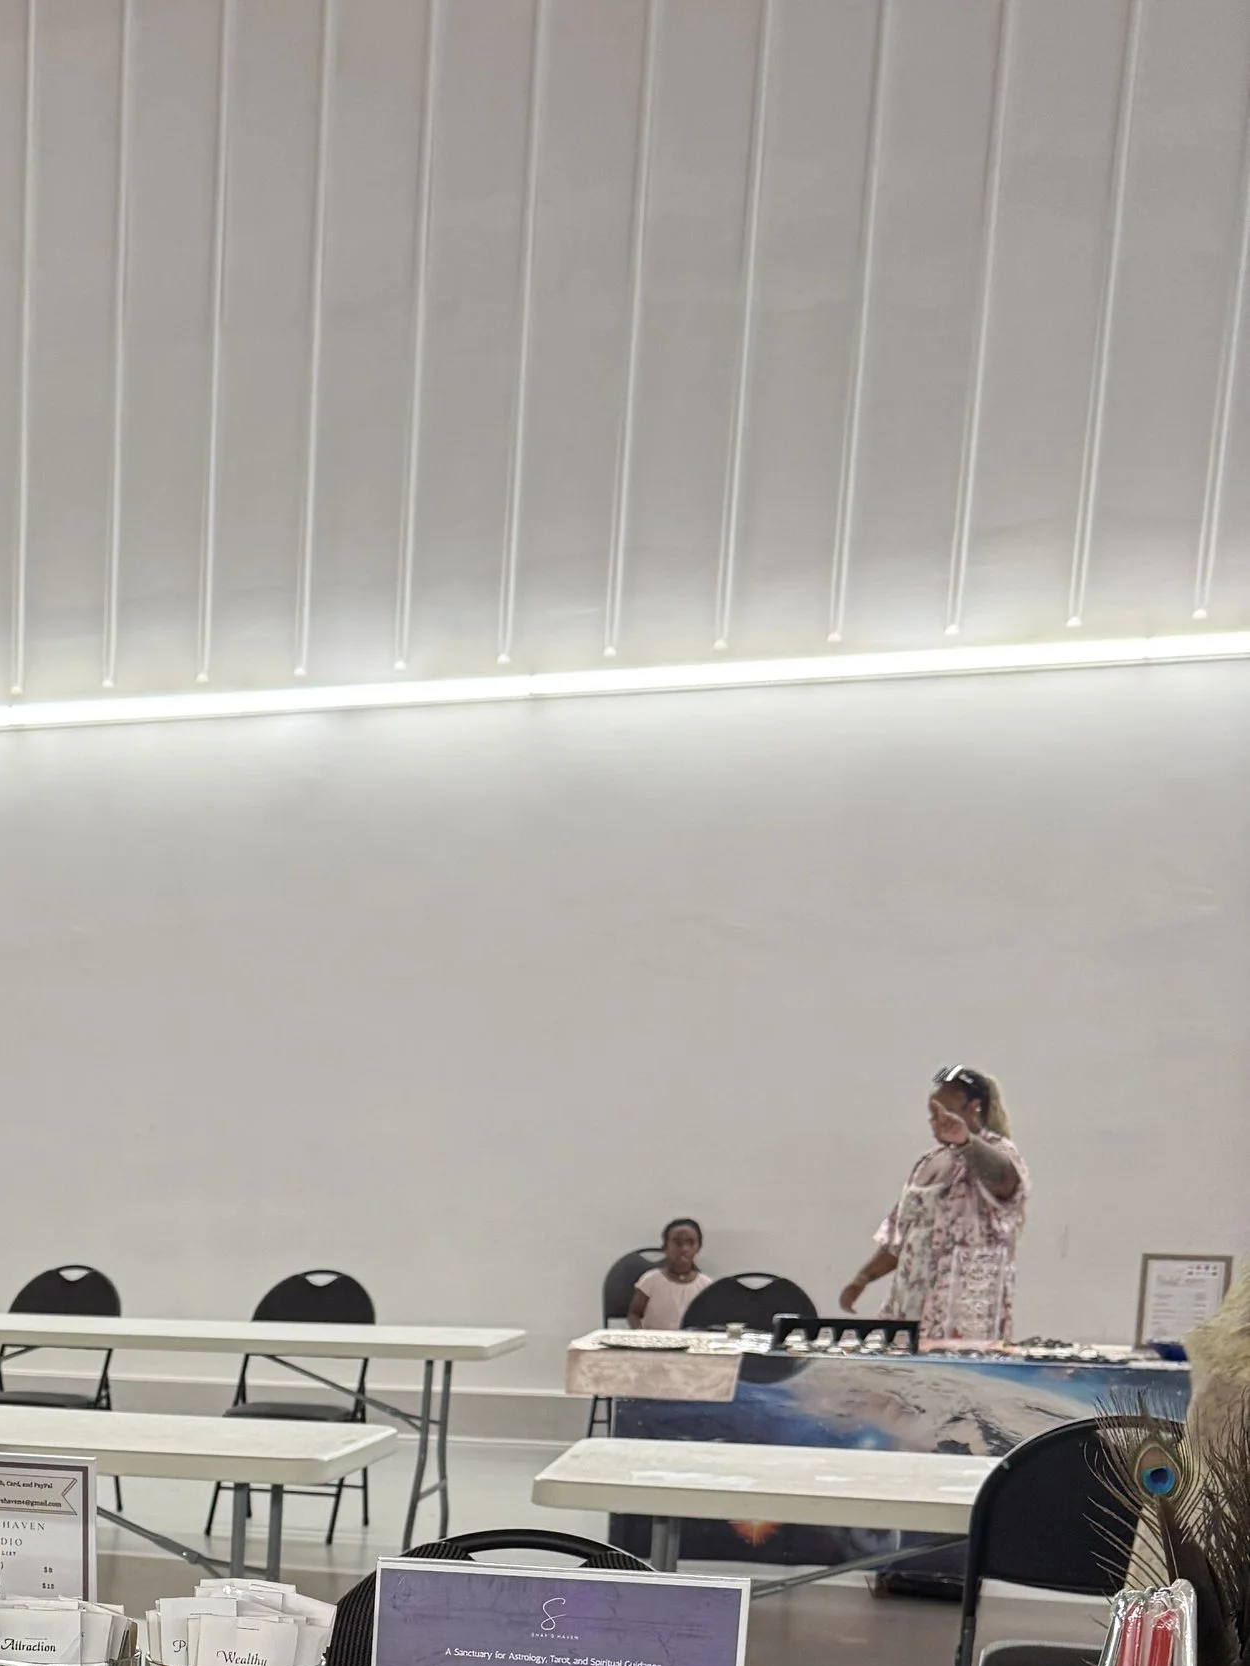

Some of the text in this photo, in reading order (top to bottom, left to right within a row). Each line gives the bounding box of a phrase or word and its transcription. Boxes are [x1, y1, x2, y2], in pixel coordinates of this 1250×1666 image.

[2, 1519, 46, 1531] HAVEN
[0, 1637, 57, 1653] Attraction
[444, 1647, 451, 1655] A
[453, 1647, 492, 1660] Sanctuary
[494, 1650, 506, 1659] for
[572, 1656, 588, 1665] and
